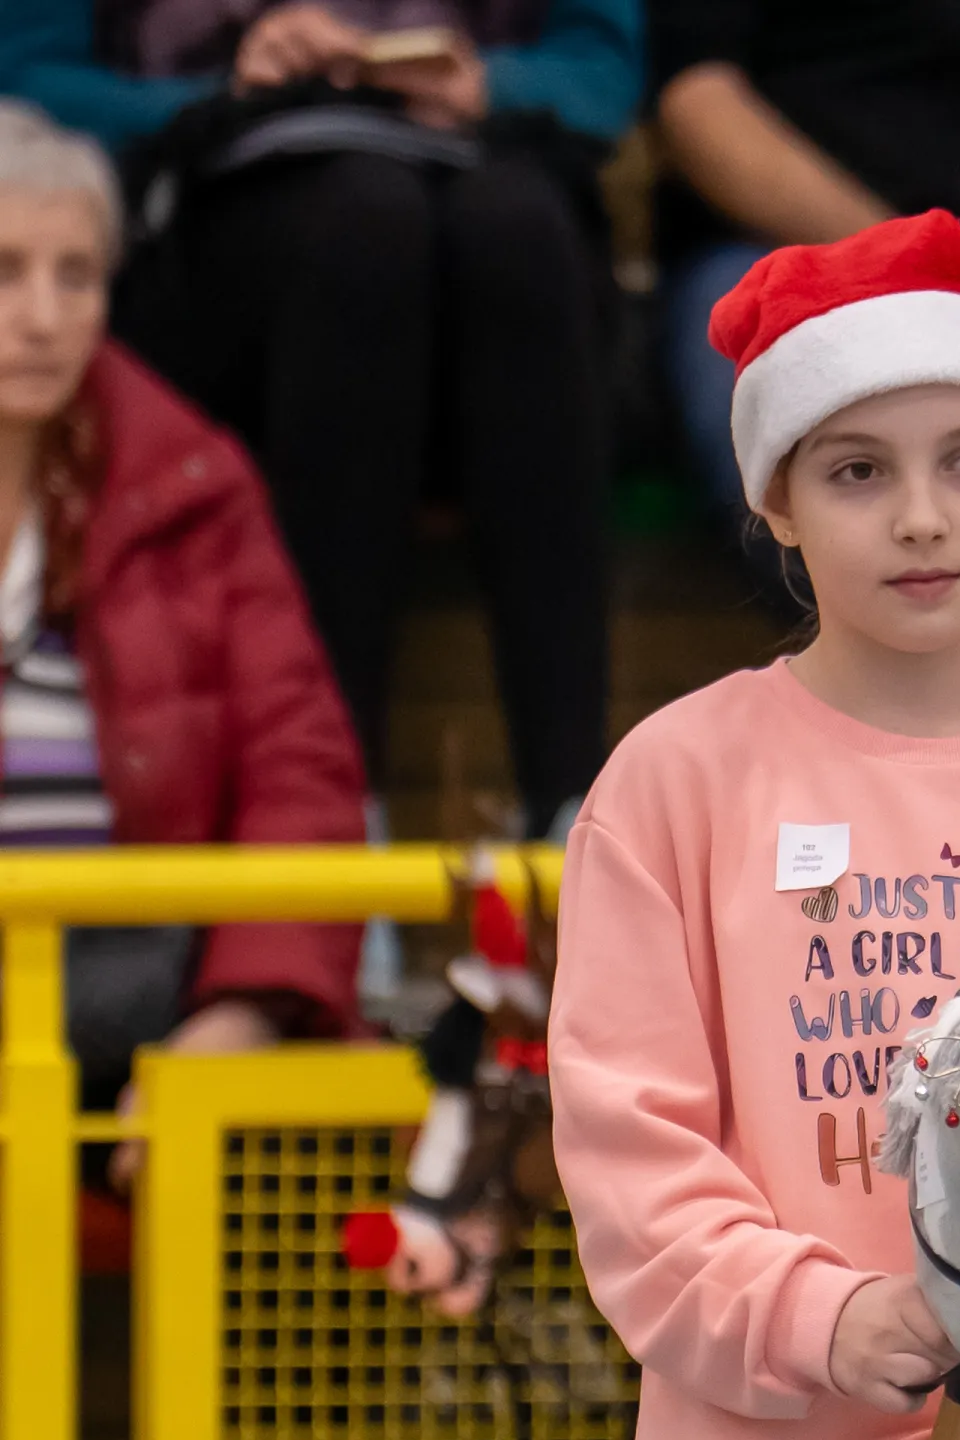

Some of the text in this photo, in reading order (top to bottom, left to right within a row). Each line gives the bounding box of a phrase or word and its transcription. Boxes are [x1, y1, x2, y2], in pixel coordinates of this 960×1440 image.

[805, 930, 956, 982] A GIRL
[789, 987, 900, 1042] WHO
